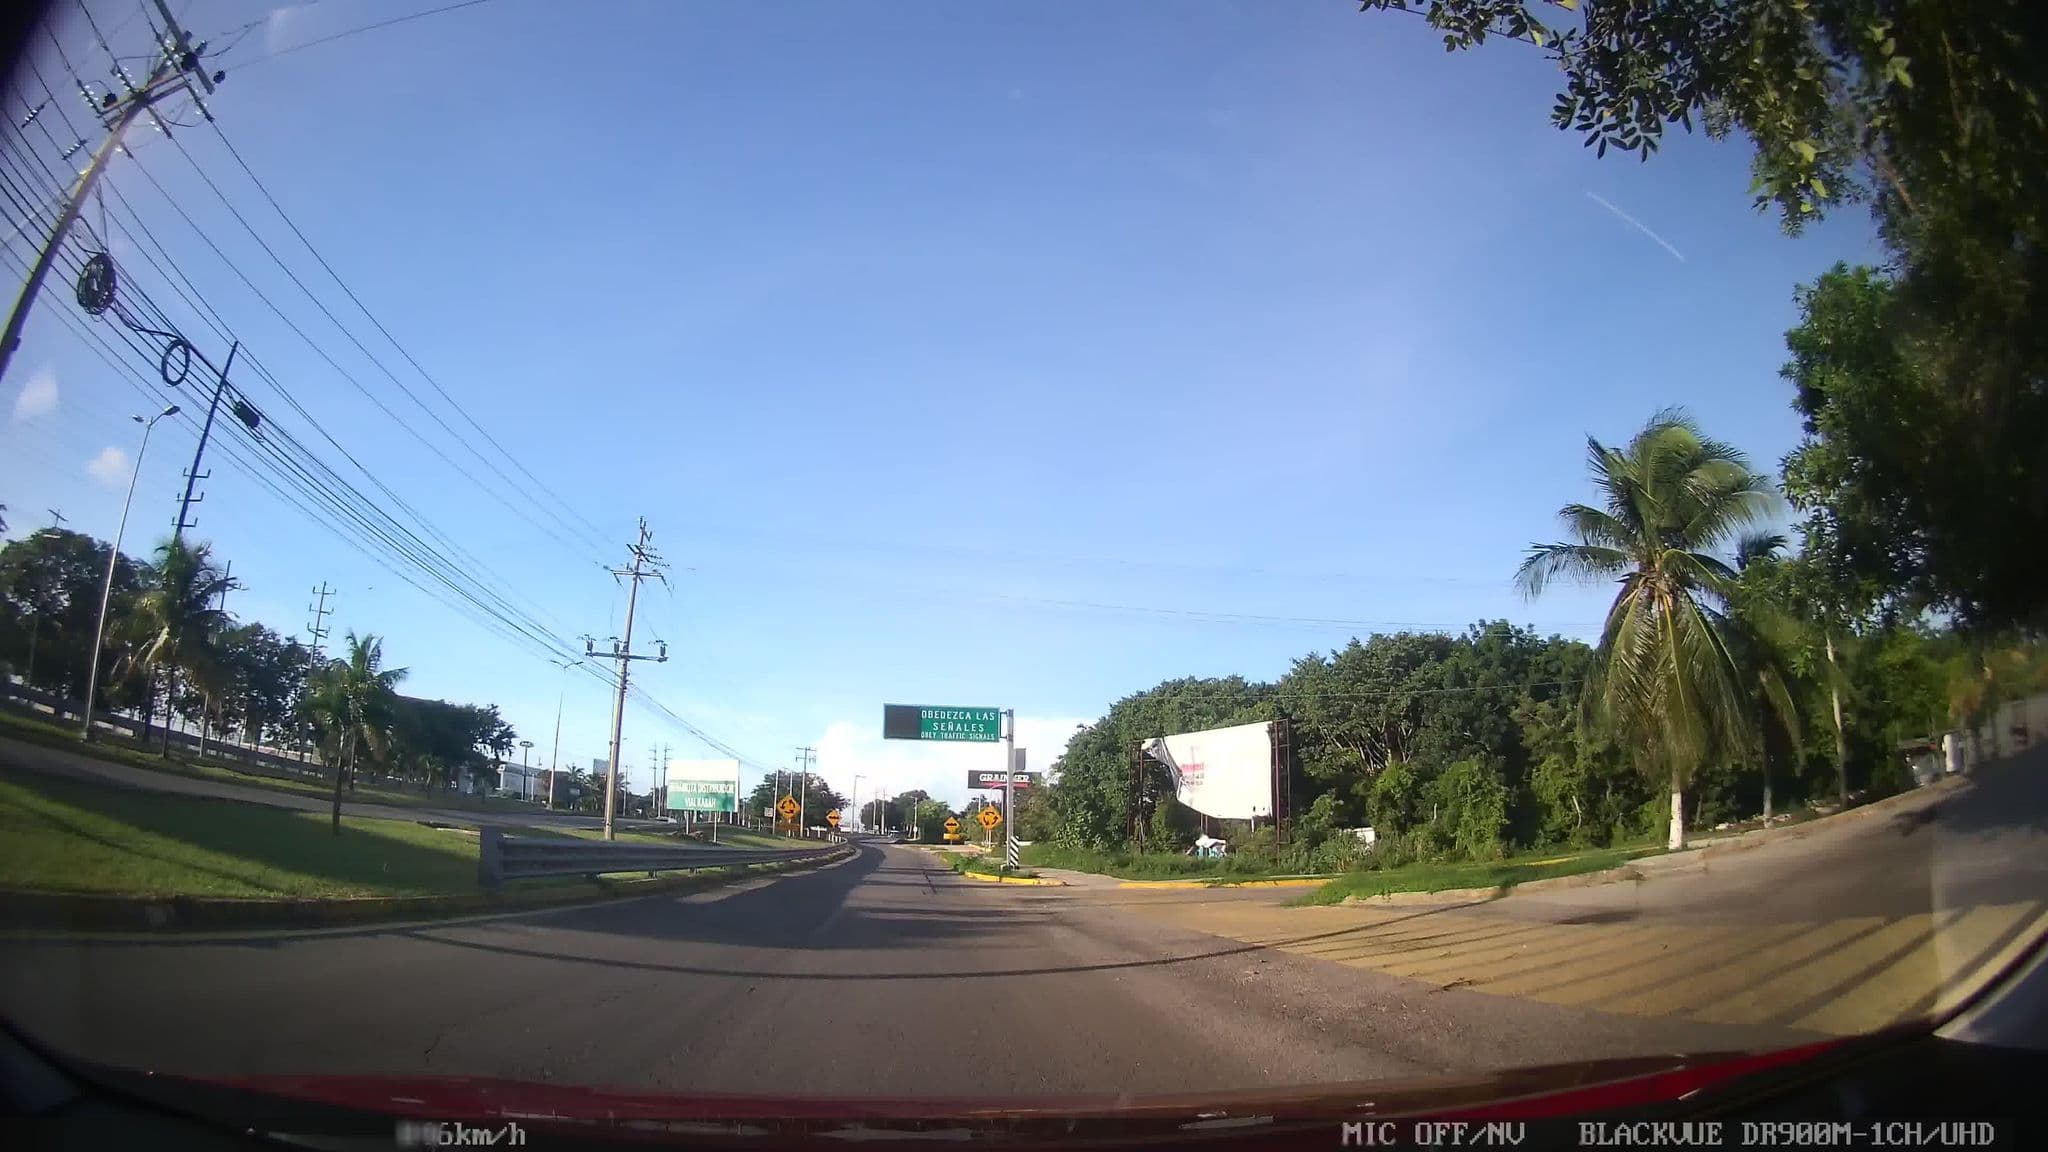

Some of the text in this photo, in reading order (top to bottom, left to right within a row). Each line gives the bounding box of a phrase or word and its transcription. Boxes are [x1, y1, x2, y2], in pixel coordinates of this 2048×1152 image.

[921, 710, 995, 721] OBEDEZCA LAS
[933, 721, 984, 732] SEÑALES
[940, 732, 966, 740] TRAFFIC
[969, 733, 995, 741] SIGNALS
